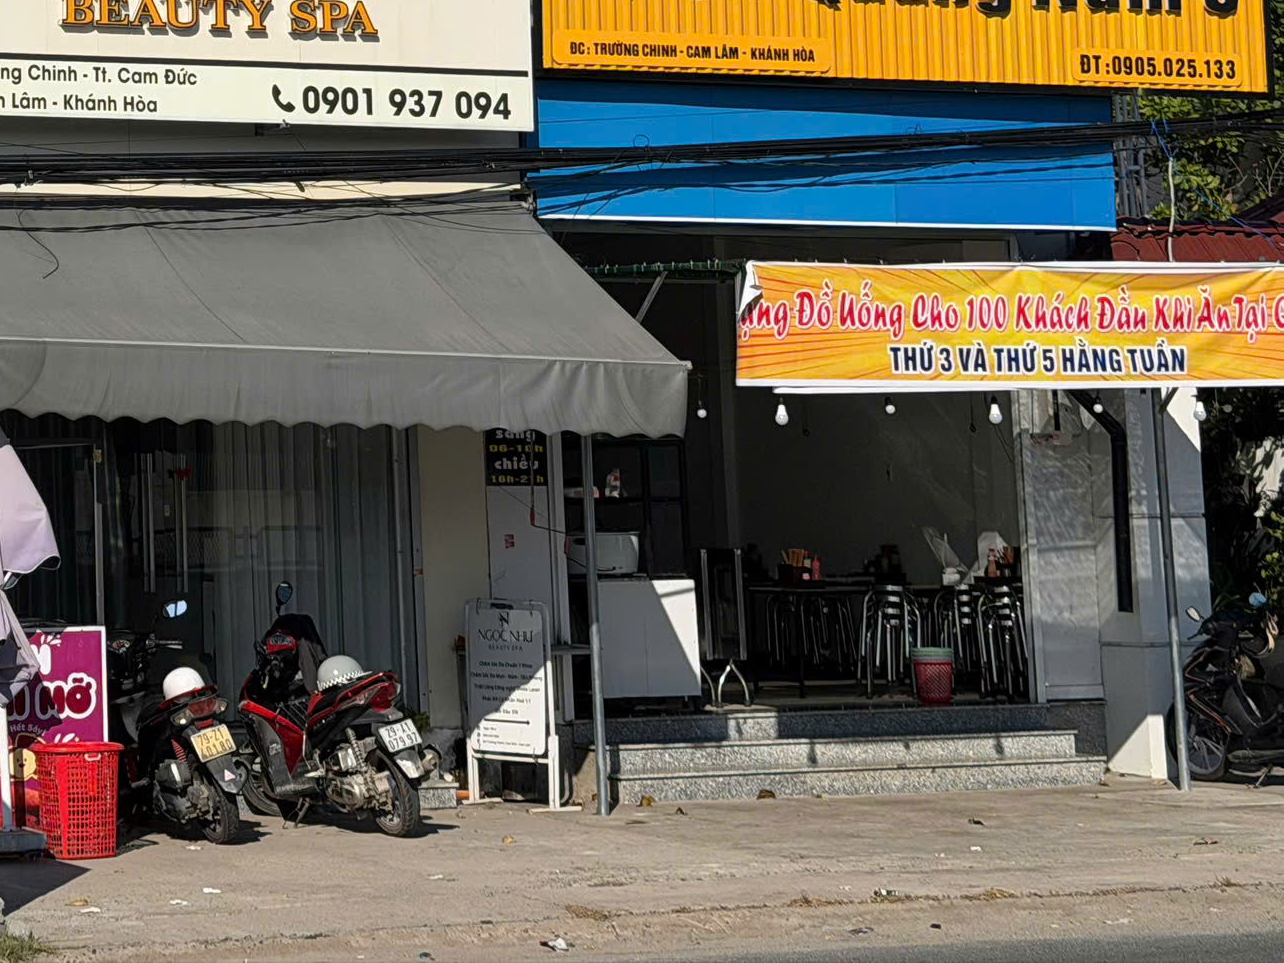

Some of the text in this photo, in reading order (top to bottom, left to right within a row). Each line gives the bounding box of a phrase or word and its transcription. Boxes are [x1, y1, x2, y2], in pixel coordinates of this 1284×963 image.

[289, 0, 379, 36] SPA
[593, 40, 640, 57] TRƯỜNG
[642, 44, 678, 58] CHINH
[686, 45, 712, 59] CAM
[715, 44, 739, 60] LÂM
[750, 45, 790, 62] KHÁNH
[793, 45, 816, 63] HÒA
[28, 65, 77, 82] Chinh
[118, 67, 158, 84] Cam
[164, 67, 198, 86] Đức
[12, 92, 47, 110] Lâm
[63, 93, 117, 112] Khánh
[123, 95, 158, 113] Hòa
[302, 85, 512, 121] 0901 937 094
[795, 280, 832, 328] Đồ
[839, 280, 904, 339] Uống
[911, 294, 959, 330] Cho
[966, 296, 1007, 330] 100
[1016, 292, 1090, 330] Khách
[1154, 295, 1194, 331] Khi
[1196, 285, 1232, 331] Ăn
[1232, 293, 1267, 342] Tại
[889, 342, 934, 372] THỨ
[938, 347, 953, 372] 3
[958, 342, 988, 373] VÀ
[993, 342, 1037, 373] THỨ
[1042, 347, 1055, 373] 5
[1126, 339, 1185, 373] TUẦN
